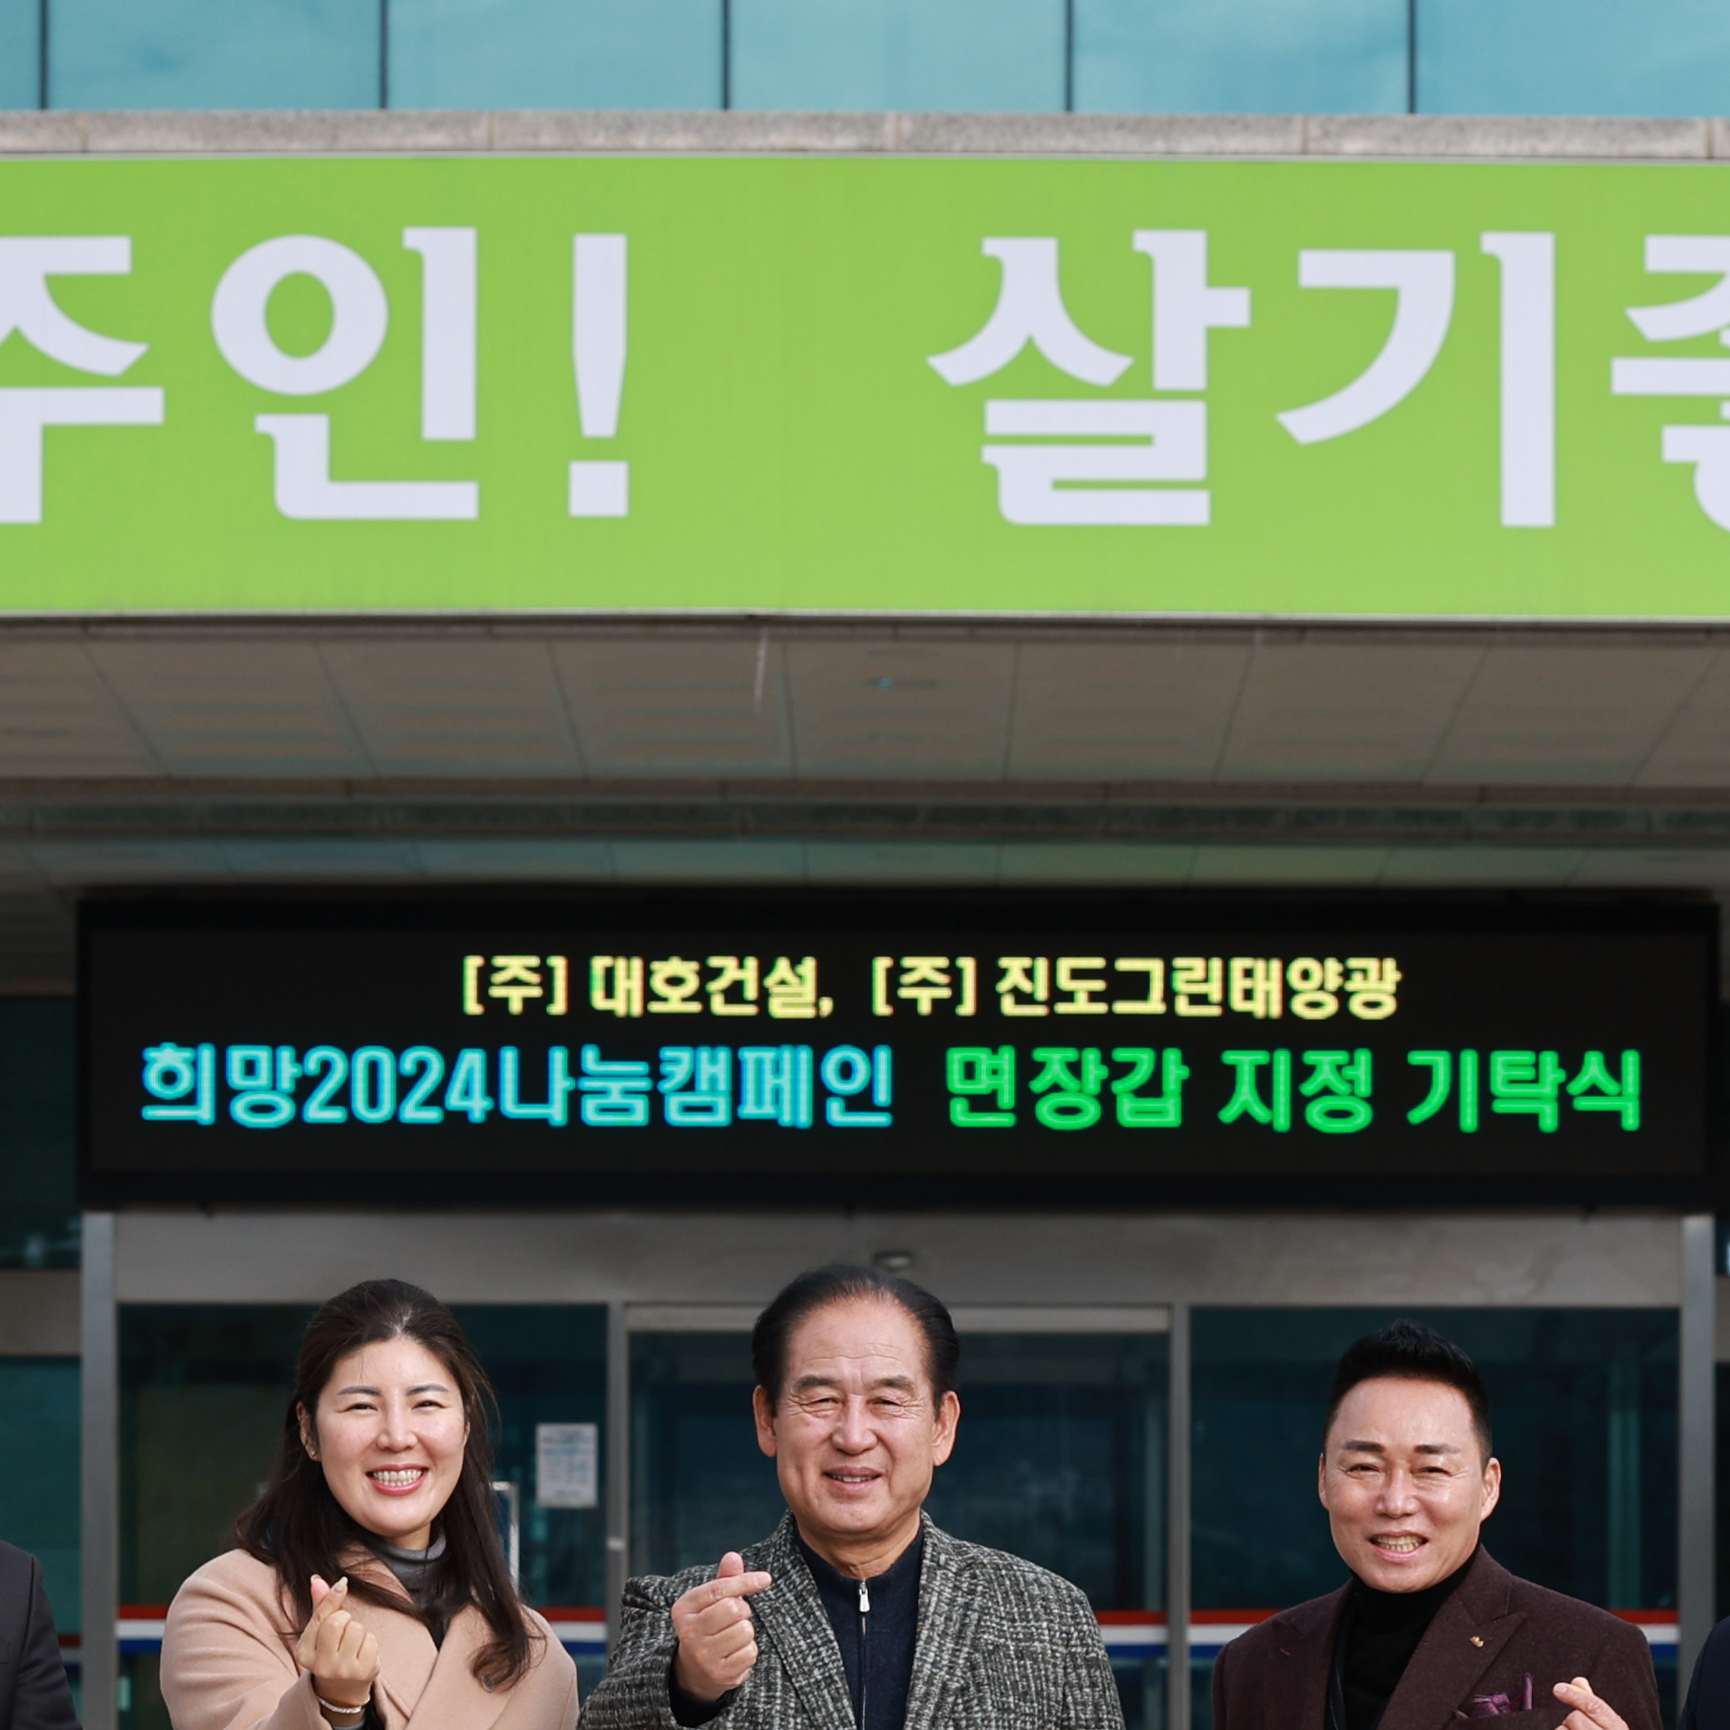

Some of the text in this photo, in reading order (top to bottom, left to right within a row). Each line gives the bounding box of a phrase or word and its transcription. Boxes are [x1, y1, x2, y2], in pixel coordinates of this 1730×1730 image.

[588, 954, 835, 1019] 대호건설,
[994, 955, 1405, 1020] 진도그린태양광
[140, 1040, 1641, 1134] 희망2024나눔캠페인 면장갑 지정 기탁식
